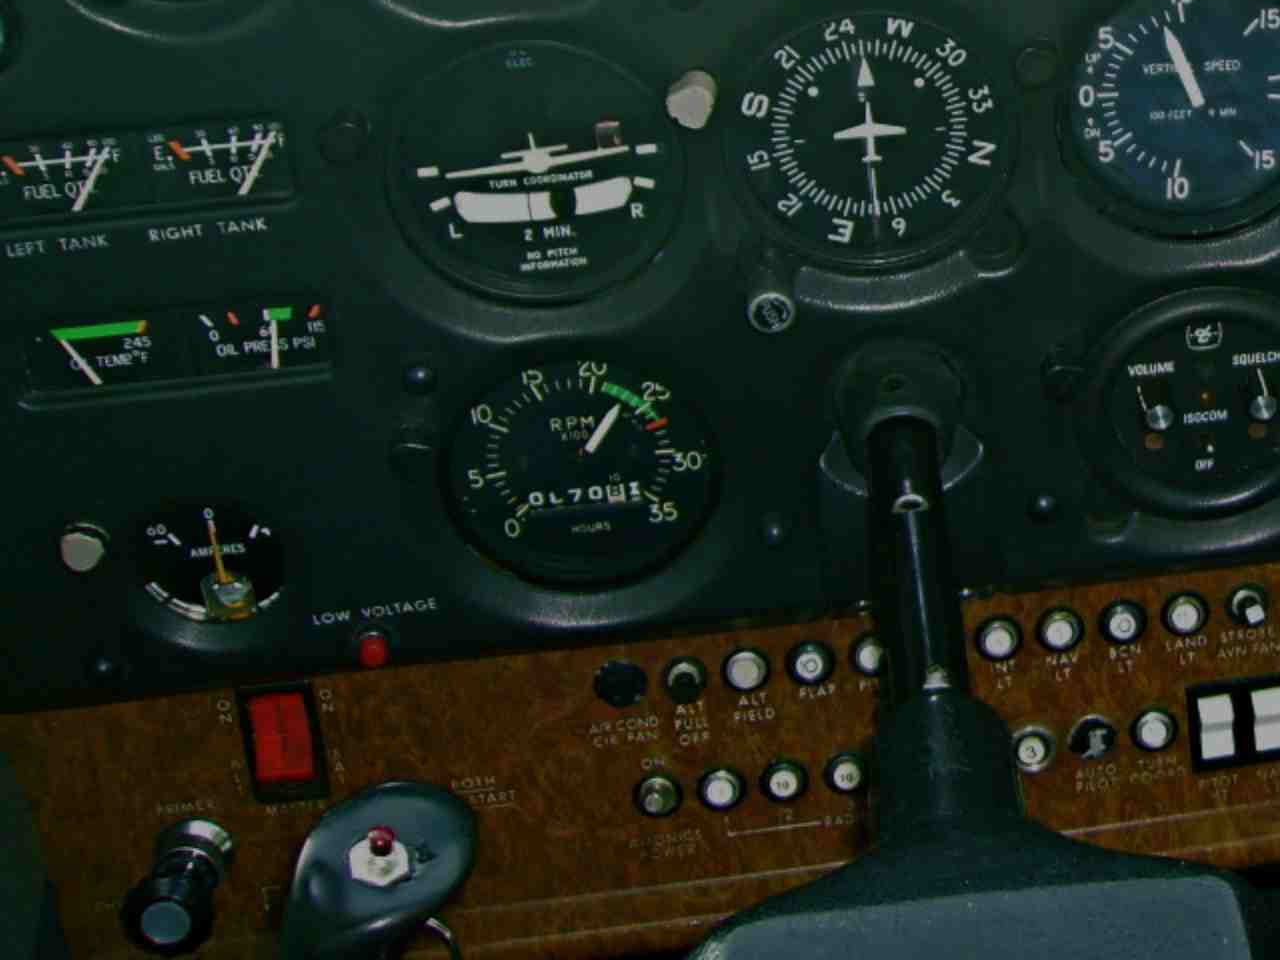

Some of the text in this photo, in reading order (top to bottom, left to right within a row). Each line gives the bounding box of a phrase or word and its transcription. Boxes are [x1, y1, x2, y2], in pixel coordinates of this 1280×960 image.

[823, 18, 856, 41] 24
[886, 16, 915, 39] W
[1098, 26, 1115, 49] 5
[773, 44, 801, 71] 21
[935, 37, 968, 67] 30
[1203, 59, 1242, 73] SPEED
[740, 91, 770, 119] S
[967, 84, 995, 114] 33
[1078, 84, 1096, 108] 0
[746, 149, 772, 172] 15
[967, 139, 998, 167] N
[1098, 139, 1116, 163] 5
[1254, 149, 1277, 170] 15
[187, 167, 227, 185] FUEL
[489, 168, 594, 191] TURN COORDINATOR
[23, 181, 64, 201] FUEL
[1165, 177, 1191, 201] 10
[629, 201, 645, 219] R
[777, 192, 804, 217] 12
[147, 215, 268, 243] RIGHT TANK
[448, 222, 464, 240] L
[522, 227, 533, 242] 2
[827, 216, 855, 244] E
[890, 216, 908, 238] 6
[5, 233, 110, 258] LEFT TANK
[526, 246, 579, 261] NO PITCH
[519, 255, 589, 272] INFORMATION
[122, 336, 153, 351] 245
[208, 328, 221, 343] 0
[577, 360, 608, 378] 20
[1127, 359, 1177, 377] VOLUME
[470, 403, 493, 425] 10
[549, 415, 596, 433] RPM
[1183, 408, 1230, 425] ISOCOM
[671, 450, 704, 473] 30
[1193, 457, 1217, 473] OFF
[466, 468, 485, 489] 5
[202, 506, 215, 520] 0
[648, 501, 680, 524] 35
[503, 518, 522, 540] 0
[570, 521, 613, 535] HOURS
[310, 596, 439, 627] LOW VOLTAGE
[1108, 644, 1142, 661] BCN
[1165, 635, 1208, 654] LAND
[1044, 652, 1079, 668] NAV
[736, 692, 768, 708] ALT
[799, 683, 837, 701] FLAP
[674, 700, 705, 716] ALT
[733, 706, 777, 722] FIELD
[615, 715, 660, 732] COND
[678, 731, 711, 747] OFF
